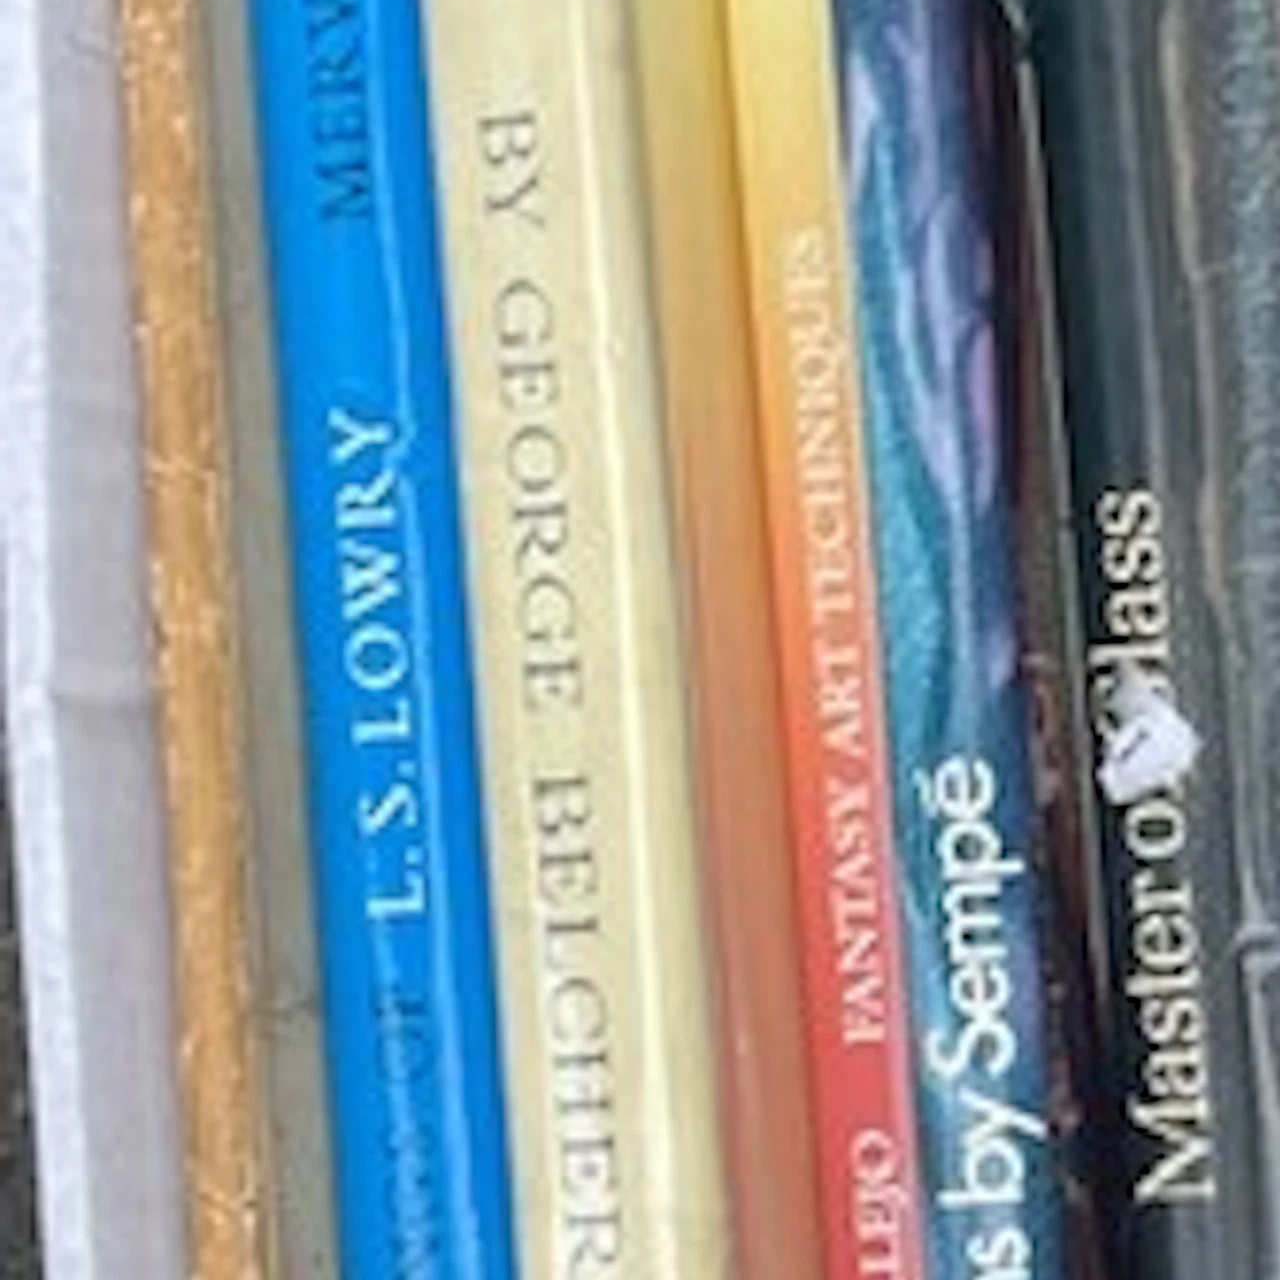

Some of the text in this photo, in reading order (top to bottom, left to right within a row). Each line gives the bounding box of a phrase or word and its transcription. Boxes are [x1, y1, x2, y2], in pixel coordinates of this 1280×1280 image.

[479, 110, 544, 226] BY
[493, 280, 583, 713] GEORGE
[783, 226, 855, 625] TECHNIQUES
[815, 634, 867, 762] ART
[826, 775, 886, 1048] FANTASY
[919, 754, 1024, 1082] Sempé
[1128, 862, 1216, 1205] Master
[935, 1112, 1045, 1217] by
